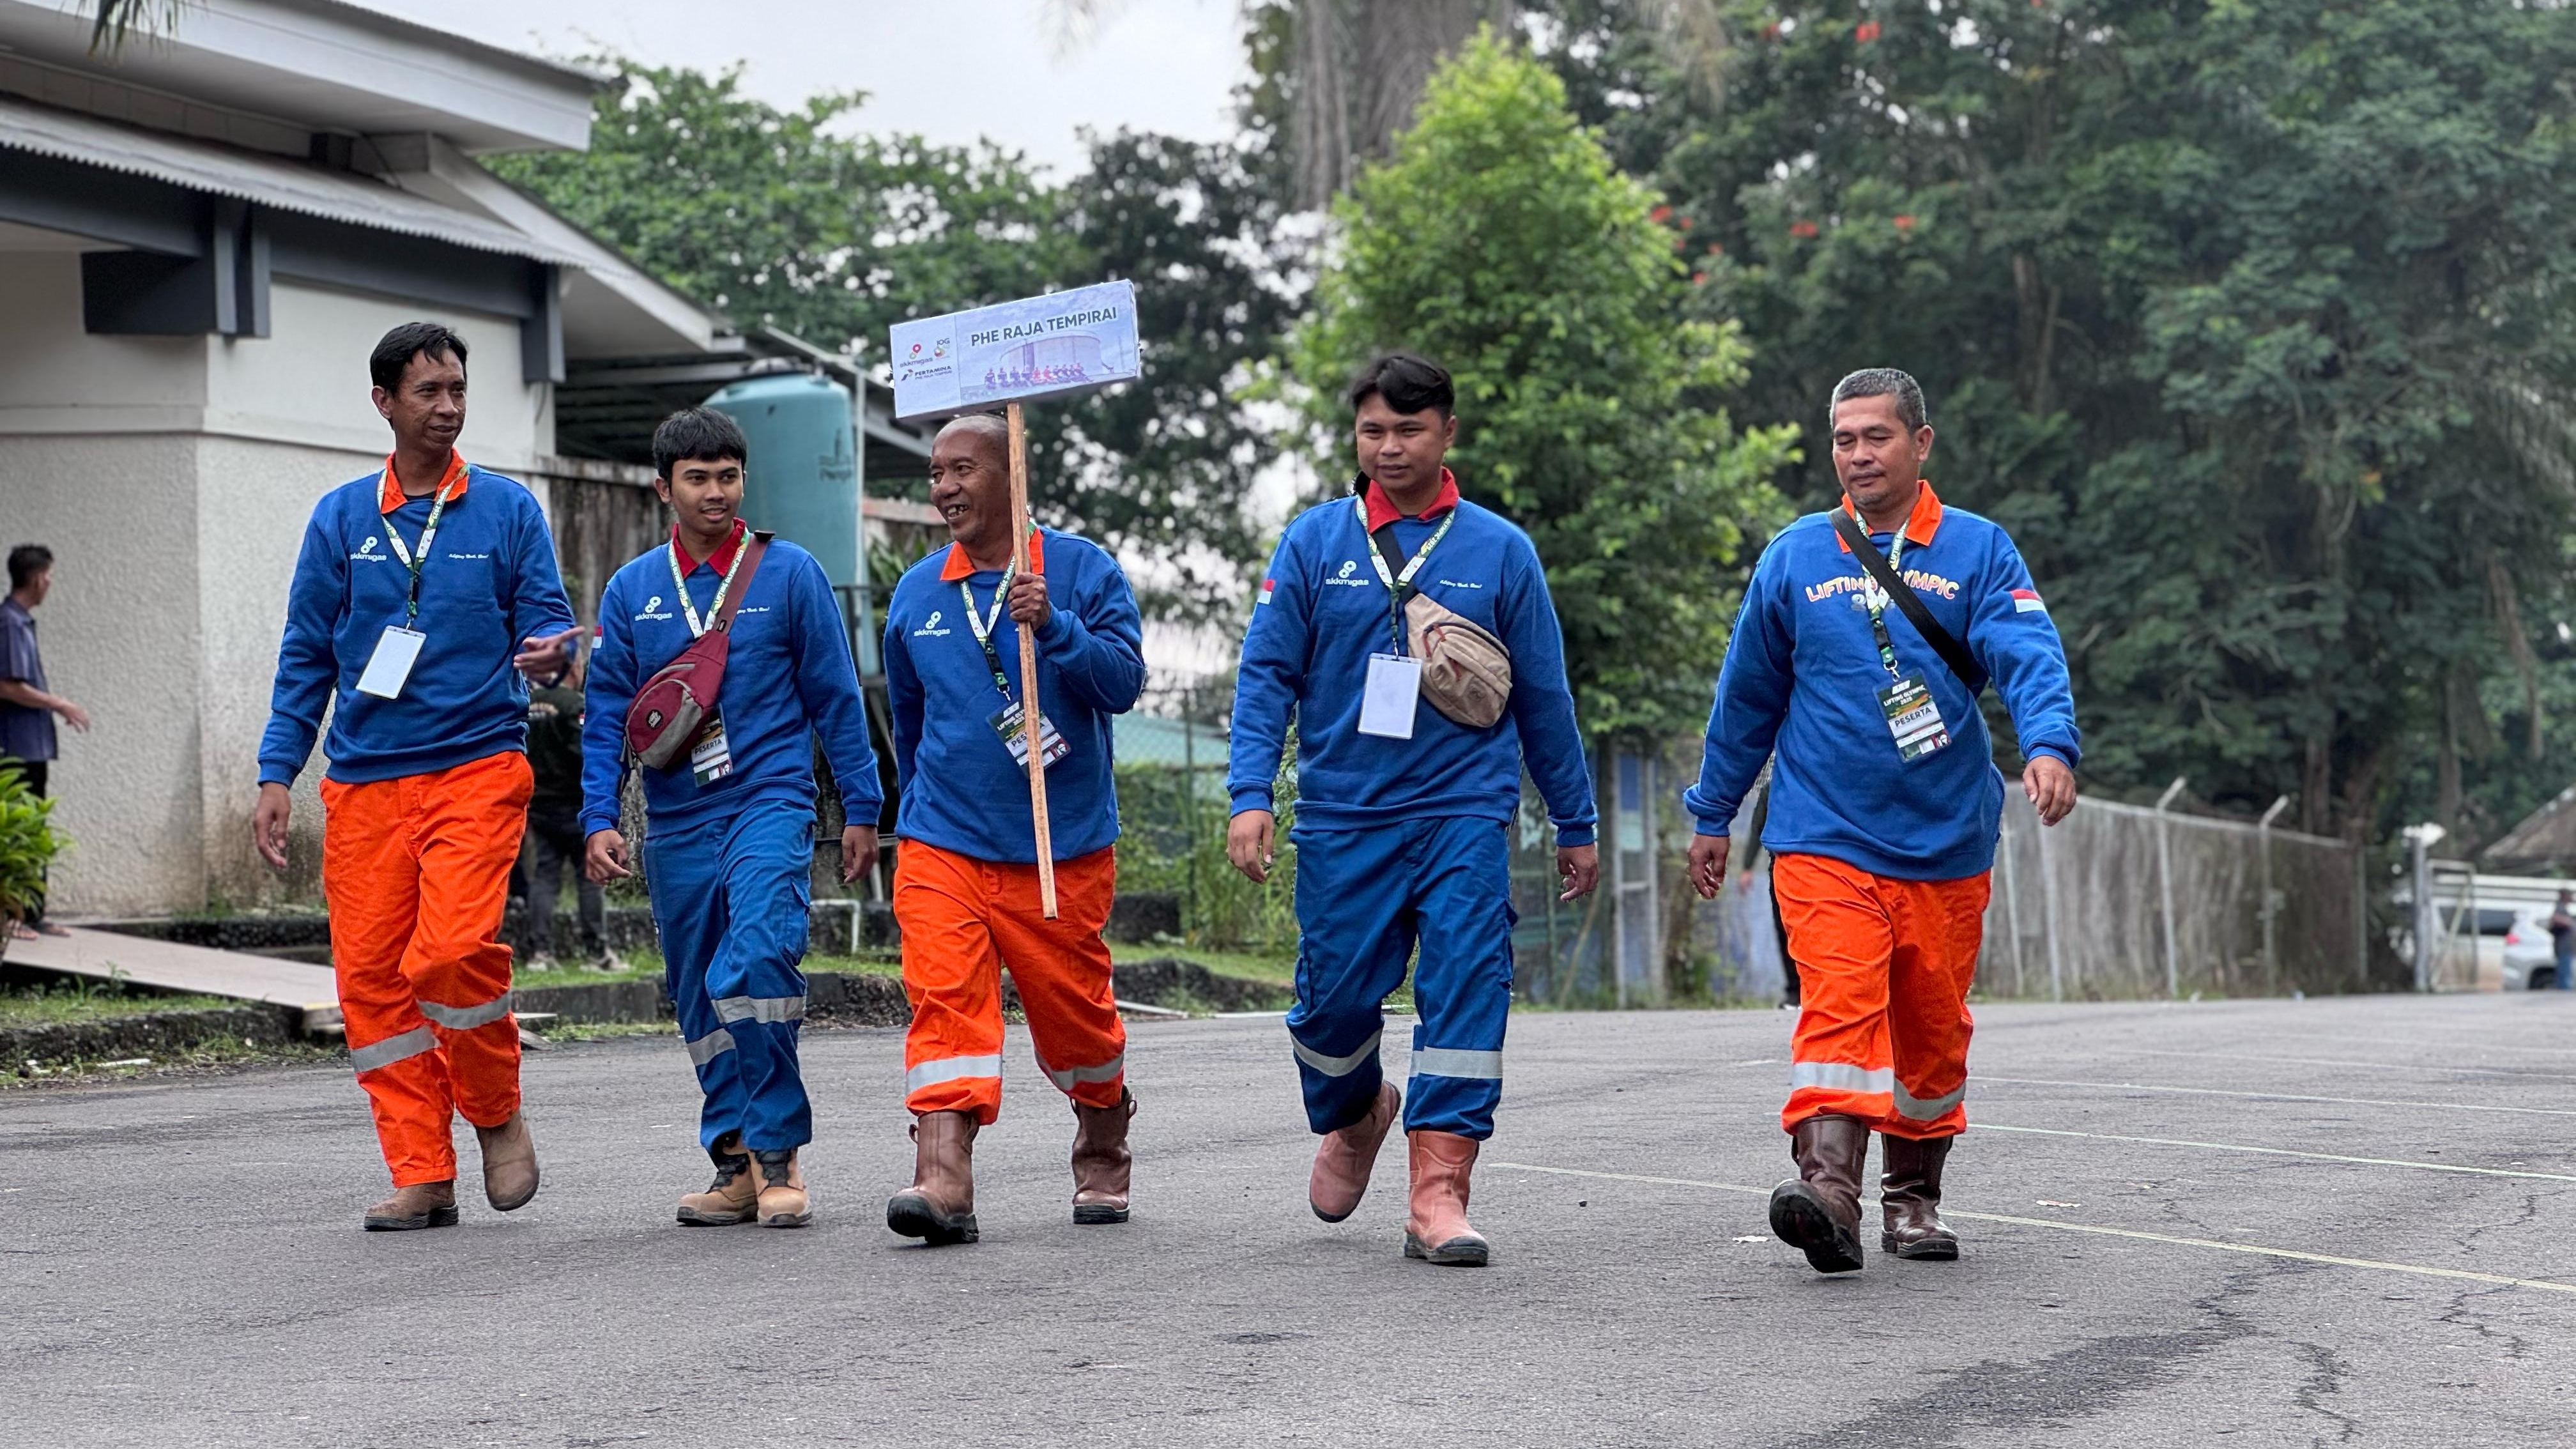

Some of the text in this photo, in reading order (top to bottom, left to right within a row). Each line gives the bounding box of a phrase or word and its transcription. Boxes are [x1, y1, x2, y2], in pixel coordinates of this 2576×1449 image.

[971, 307, 1117, 346] PHE RAJA TEMPIRAI
[900, 357, 933, 368] skkmigas
[915, 365, 951, 376] PERTAMINA
[350, 553, 387, 562] skkmigas
[1325, 578, 1369, 587] skkmigas
[1899, 569, 1959, 600] YMPIC
[635, 613, 672, 621] skkmigas
[914, 629, 950, 637] skkmigas
[1894, 707, 1932, 727] PESERTA
[1011, 722, 1045, 747] PESA
[694, 739, 722, 755] PESERTA
